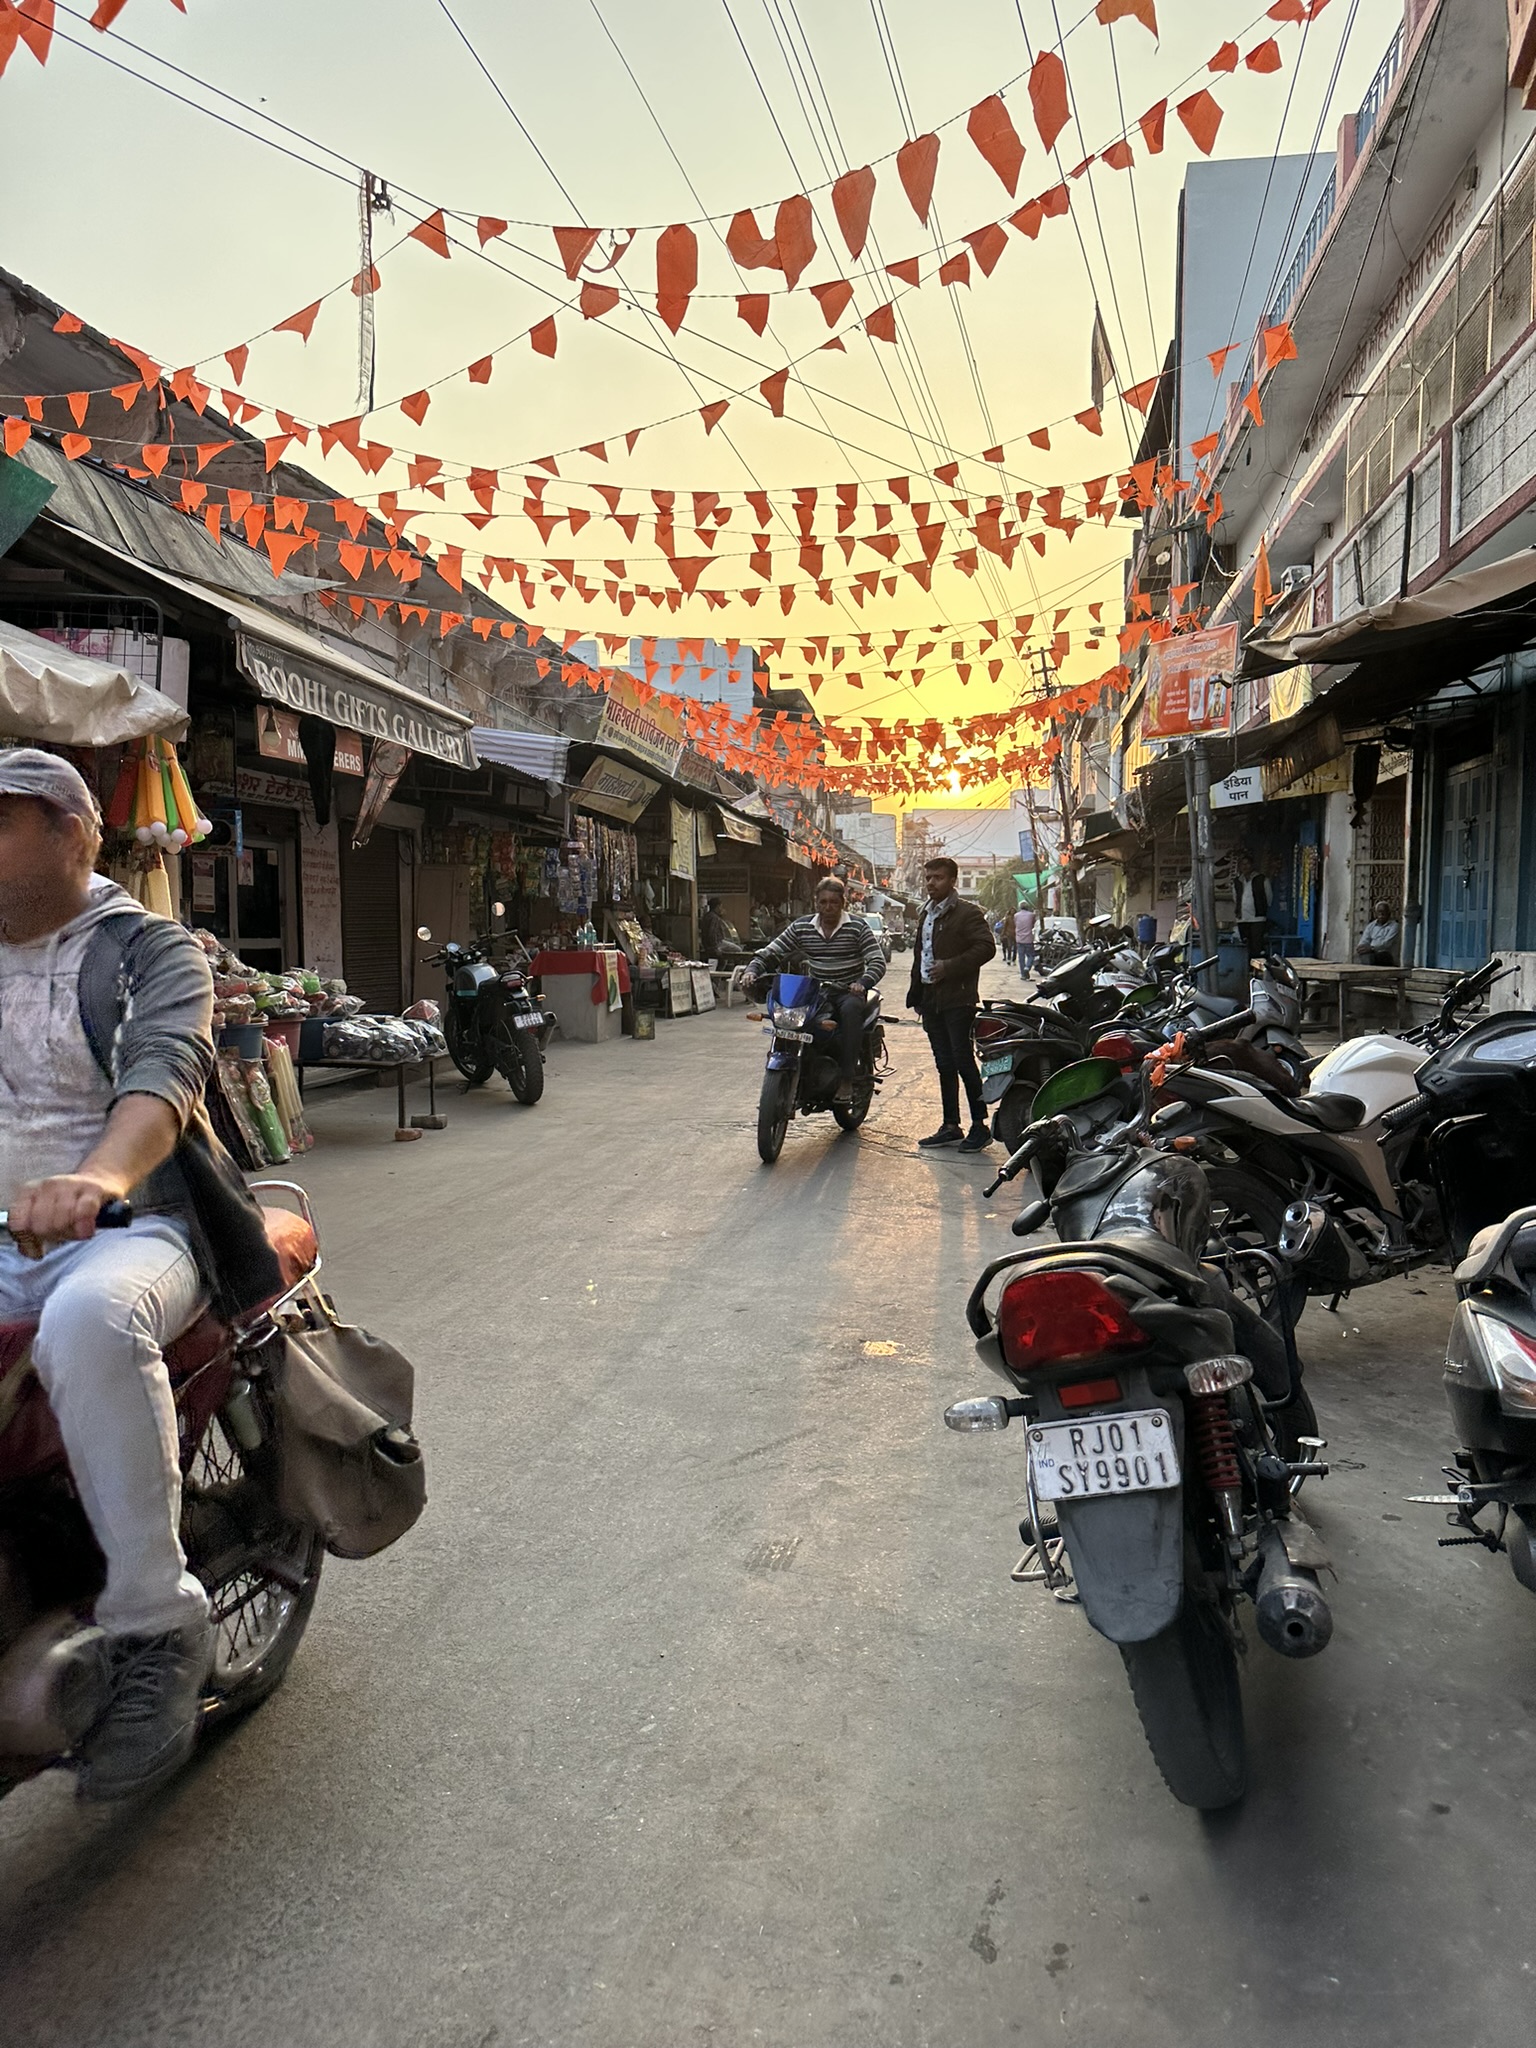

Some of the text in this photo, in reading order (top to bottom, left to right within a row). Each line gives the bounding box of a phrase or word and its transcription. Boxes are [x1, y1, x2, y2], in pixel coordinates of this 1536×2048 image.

[1403, 248, 1426, 308] सेवा
[1425, 198, 1457, 275] सदन
[333, 690, 388, 737] GIFTS
[393, 714, 465, 763] GALLERY
[606, 696, 641, 735] माहेश्वरी
[1229, 791, 1249, 801] पान
[1069, 1420, 1141, 1457] RJ01
[1038, 1458, 1055, 1469] IND
[1058, 1452, 1168, 1494] SY9901
